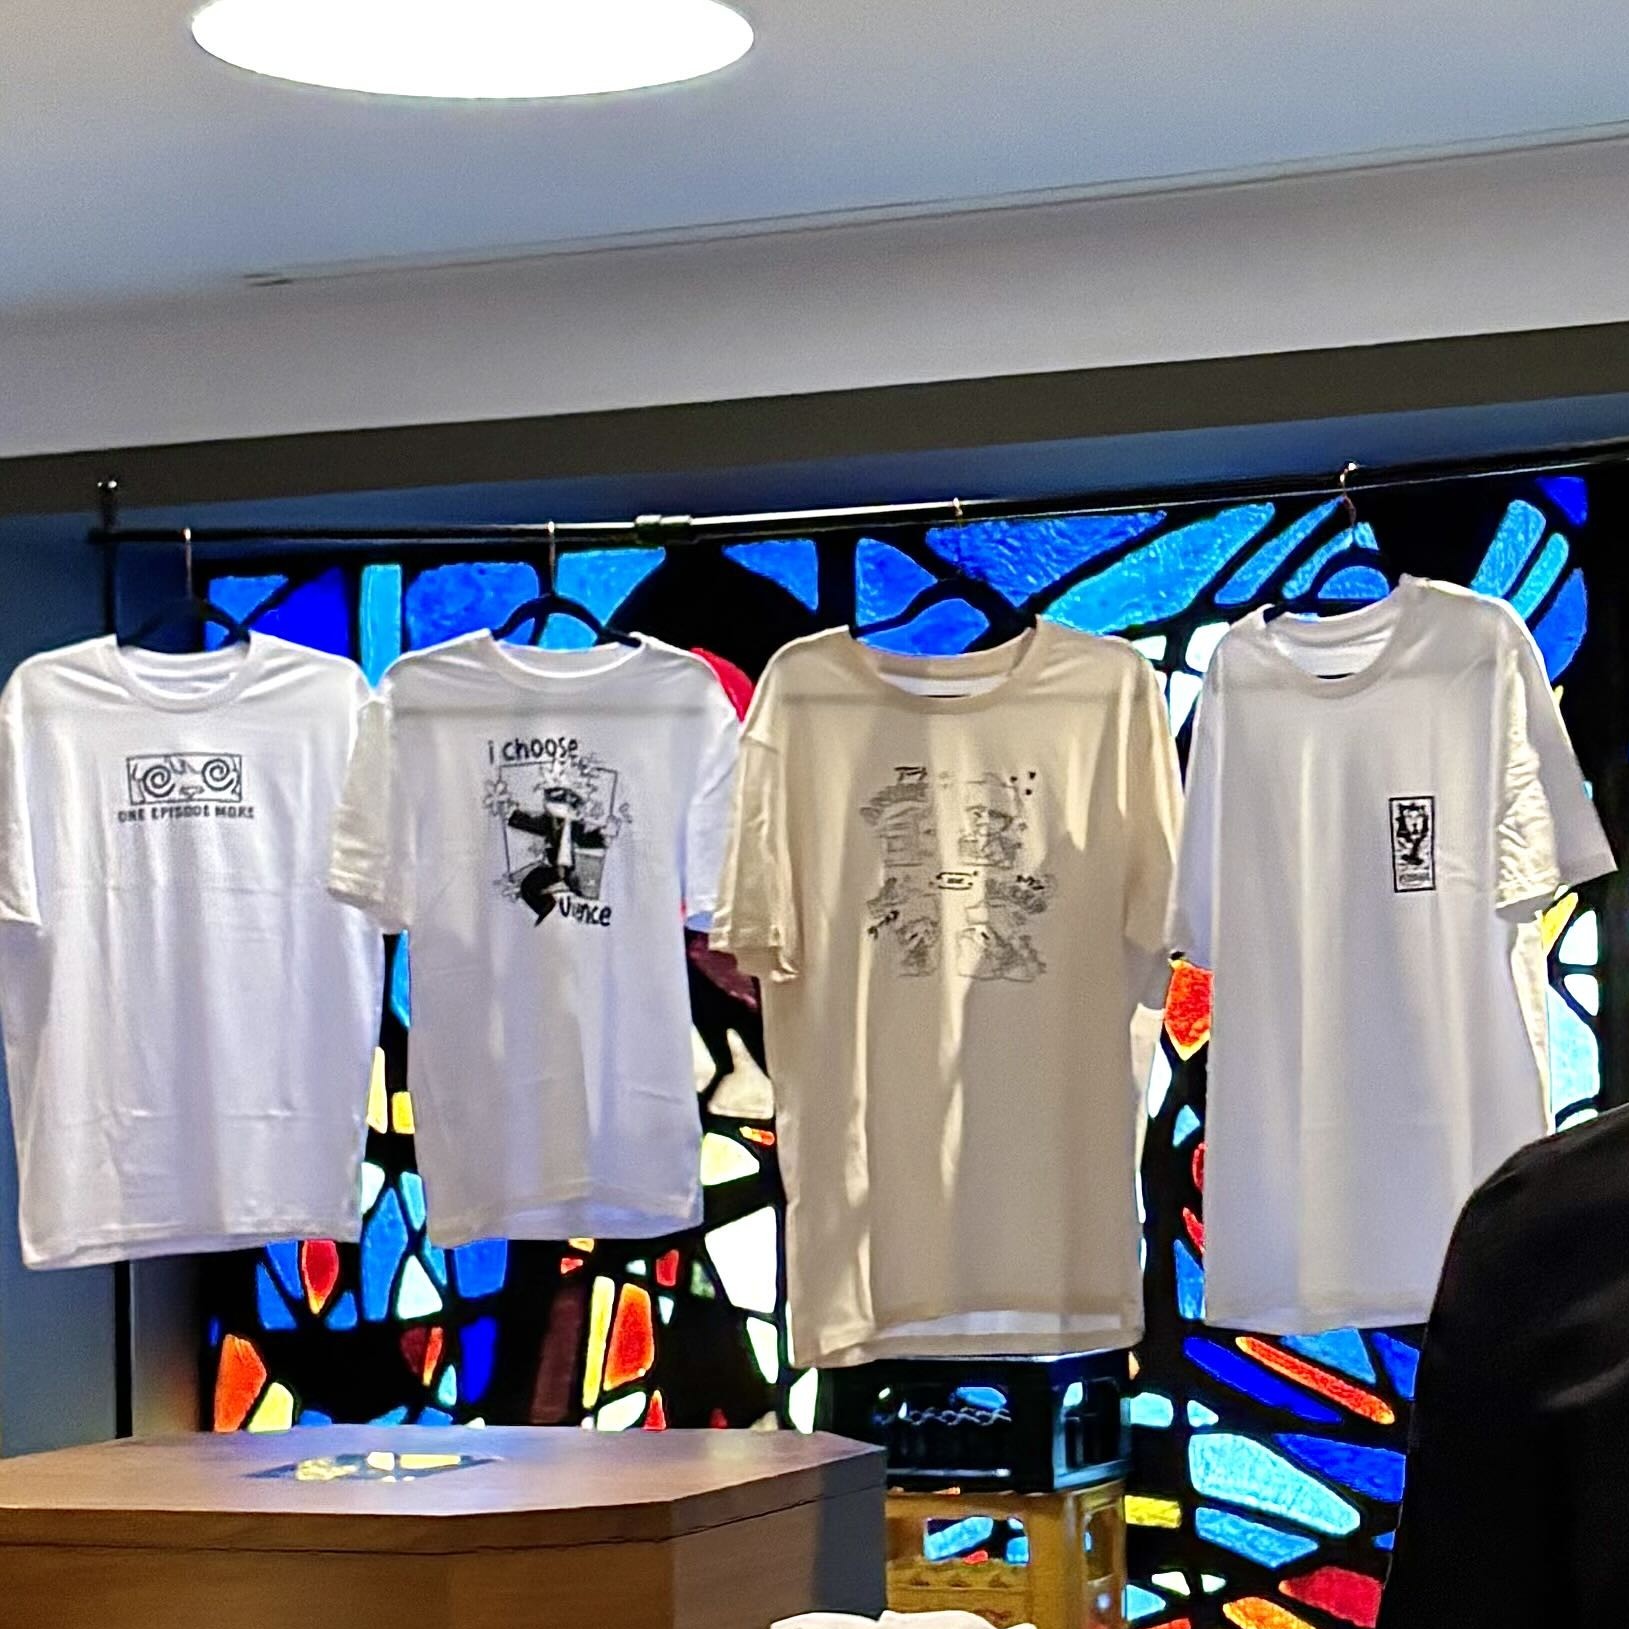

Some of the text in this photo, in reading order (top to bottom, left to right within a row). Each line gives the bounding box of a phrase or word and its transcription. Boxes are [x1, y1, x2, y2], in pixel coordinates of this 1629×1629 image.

[502, 737, 578, 762] choose
[118, 804, 255, 823] ONE EPISODE MORE
